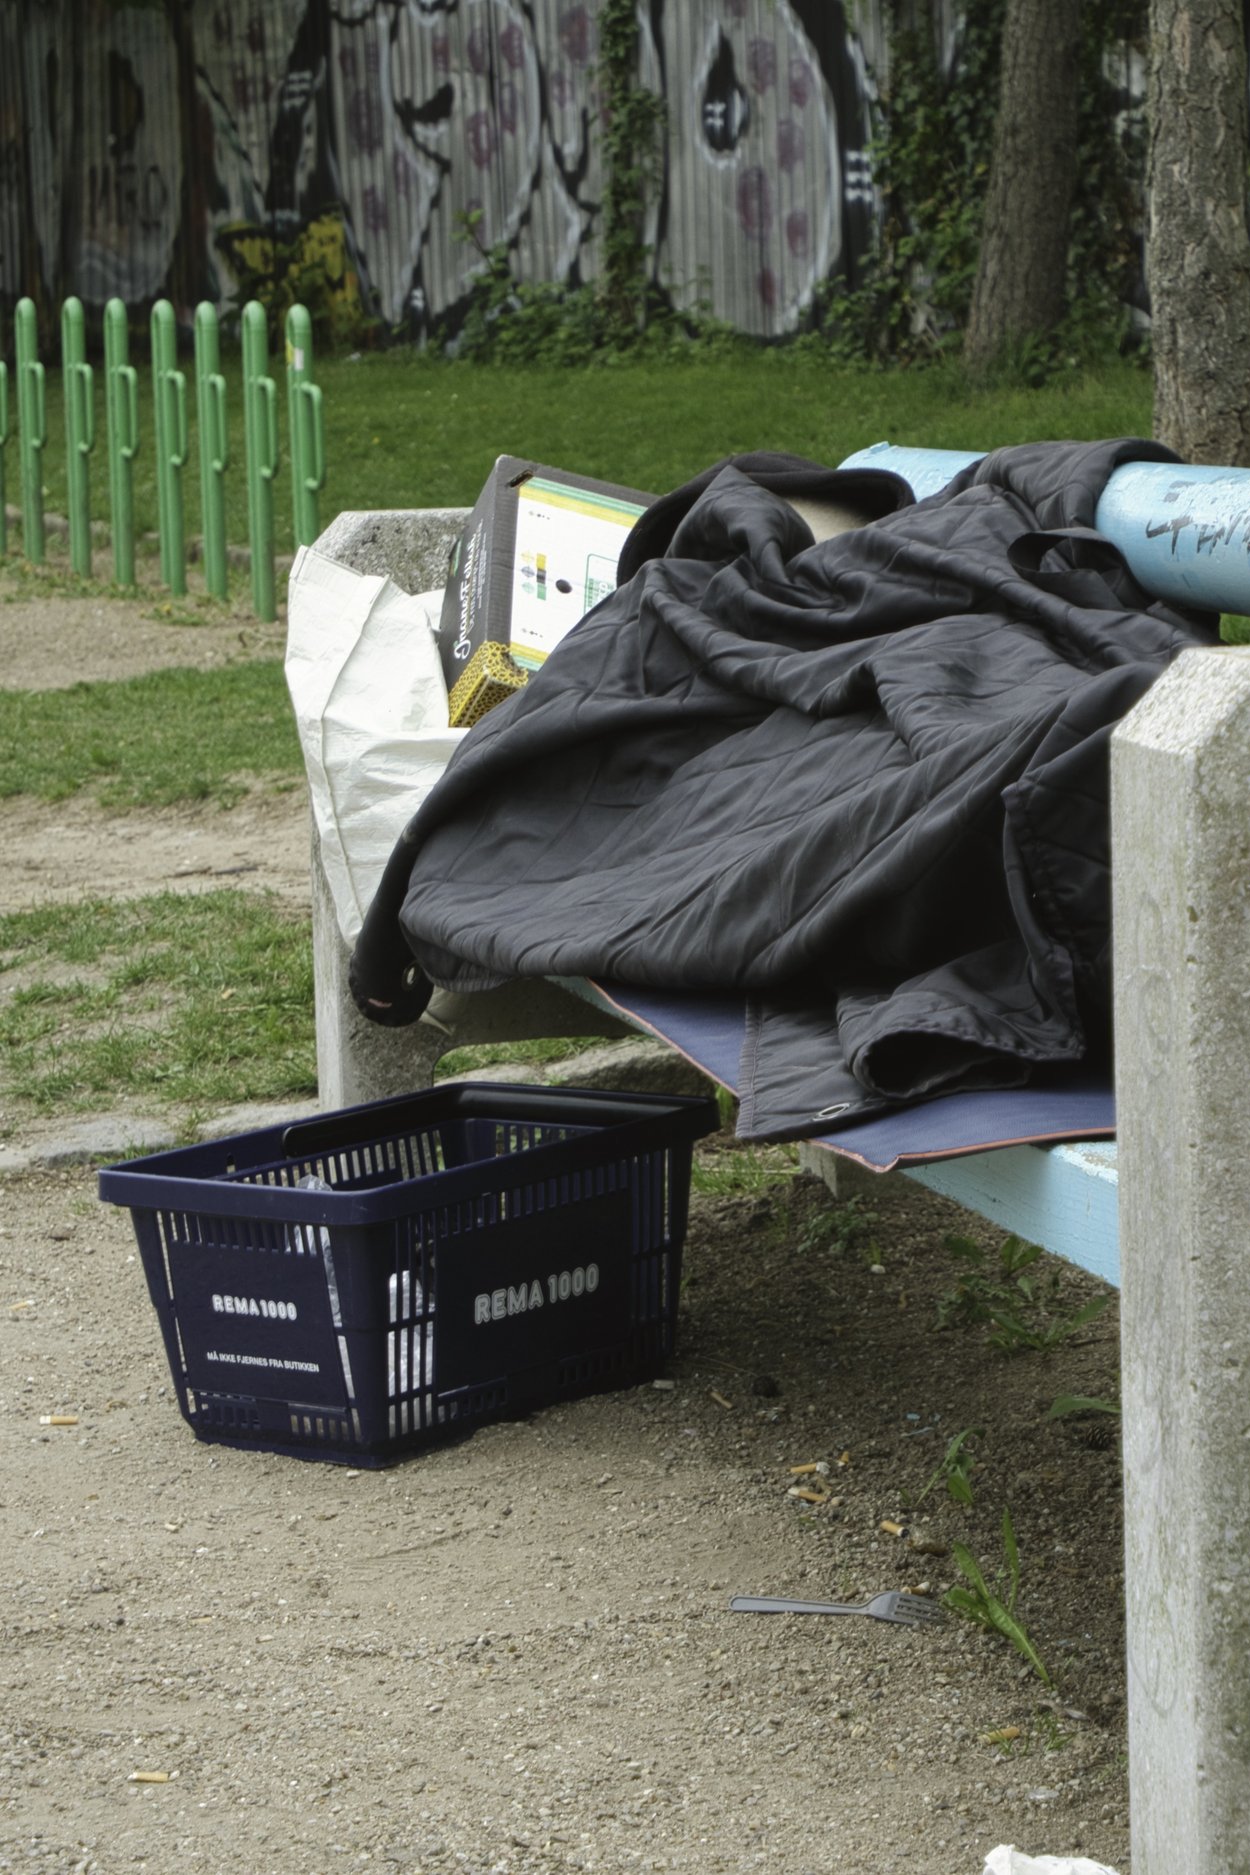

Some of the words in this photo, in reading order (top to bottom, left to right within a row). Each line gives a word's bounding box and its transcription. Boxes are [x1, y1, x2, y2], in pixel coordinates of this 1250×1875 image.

[211, 1294, 260, 1316] REMA
[259, 1299, 298, 1321] 1000
[474, 1279, 544, 1325] REMA
[547, 1263, 600, 1304] 1000
[206, 1350, 219, 1361] MÅ
[219, 1353, 237, 1363] IKKE
[236, 1355, 268, 1367] FJERNES
[268, 1358, 284, 1369] FRA
[284, 1360, 320, 1373] BUTIKKEN
